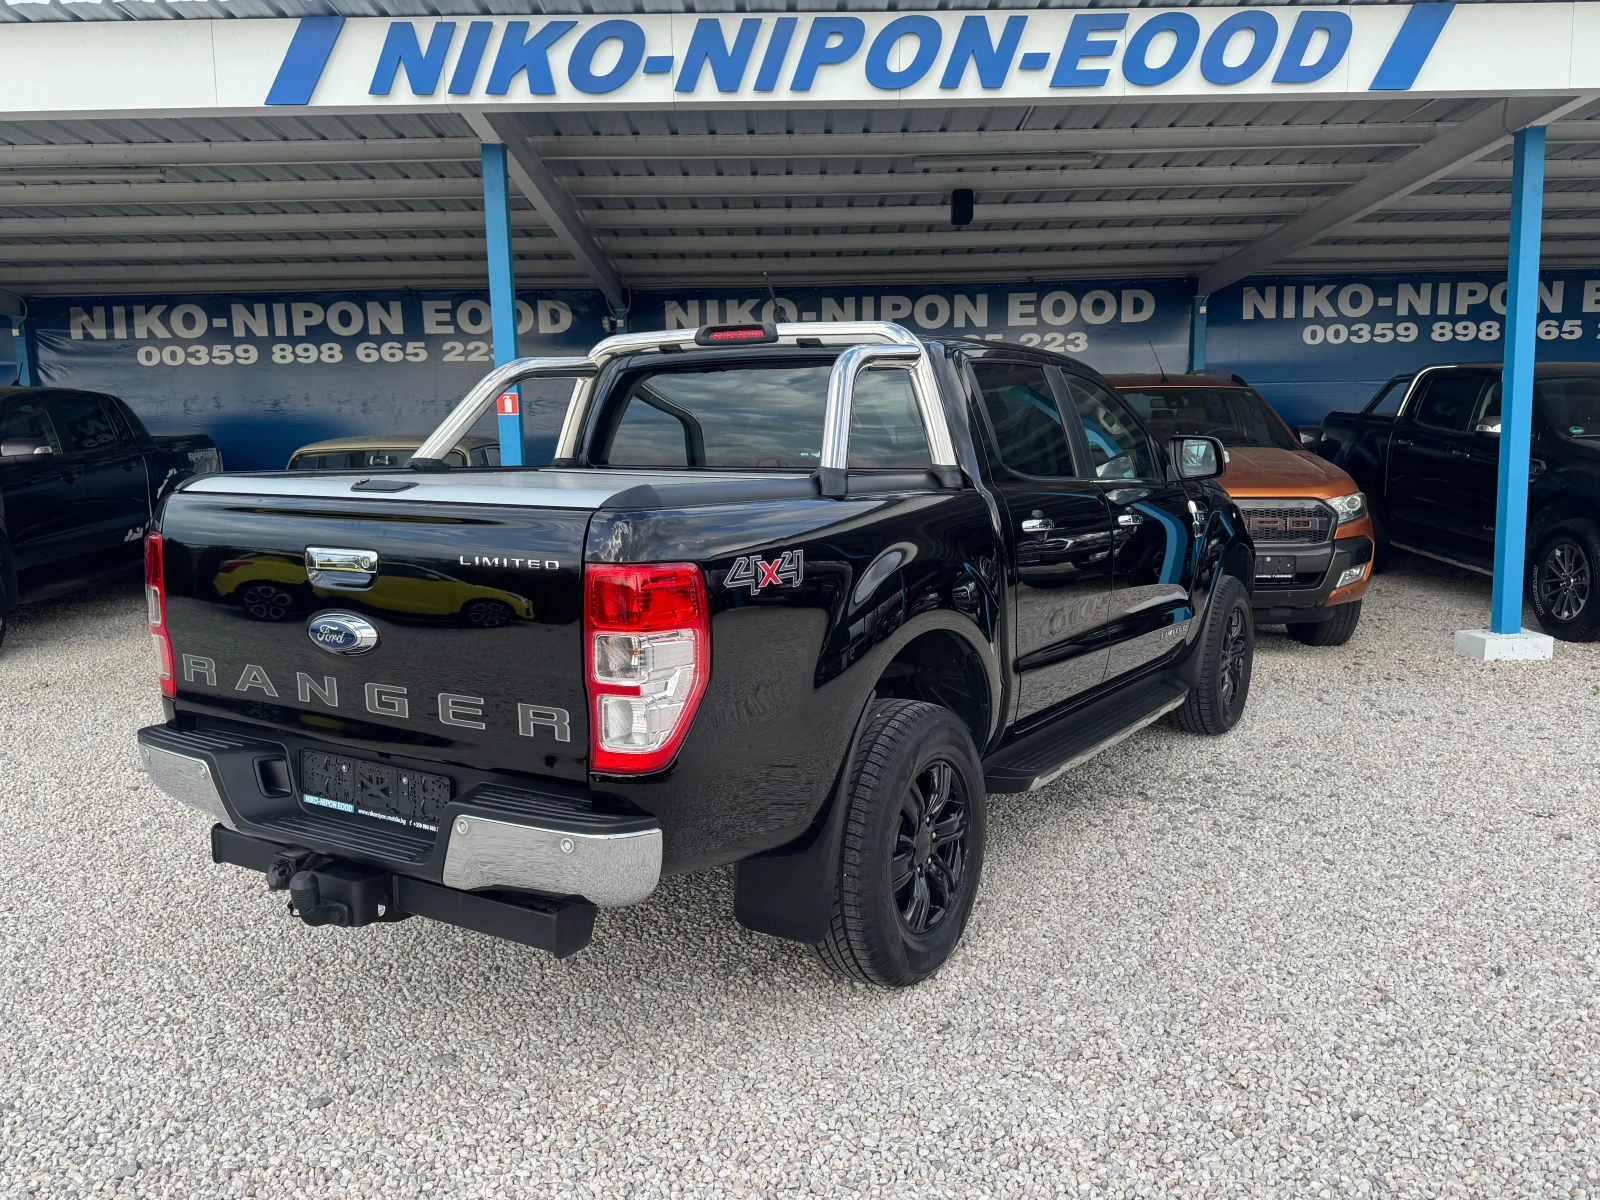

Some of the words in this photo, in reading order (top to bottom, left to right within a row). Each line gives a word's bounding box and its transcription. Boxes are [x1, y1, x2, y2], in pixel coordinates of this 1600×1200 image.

[368, 6, 1353, 96] NIKO-NIPON-EOOD
[69, 300, 404, 341] NIKO-NIPON
[664, 294, 988, 331] NIKO-NIPON
[1007, 289, 1156, 327] EOOD
[1302, 322, 1418, 345] 00359
[1430, 320, 1501, 341] 898
[1536, 319, 1583, 340] 65
[137, 343, 258, 367] 00359
[271, 342, 343, 364] 898
[356, 341, 428, 362] 665
[442, 341, 494, 361] 22
[460, 556, 560, 570] LIMITED
[317, 624, 346, 644] Ford
[182, 653, 571, 742] RANGER
[305, 795, 337, 809] NIKO-NIPON
